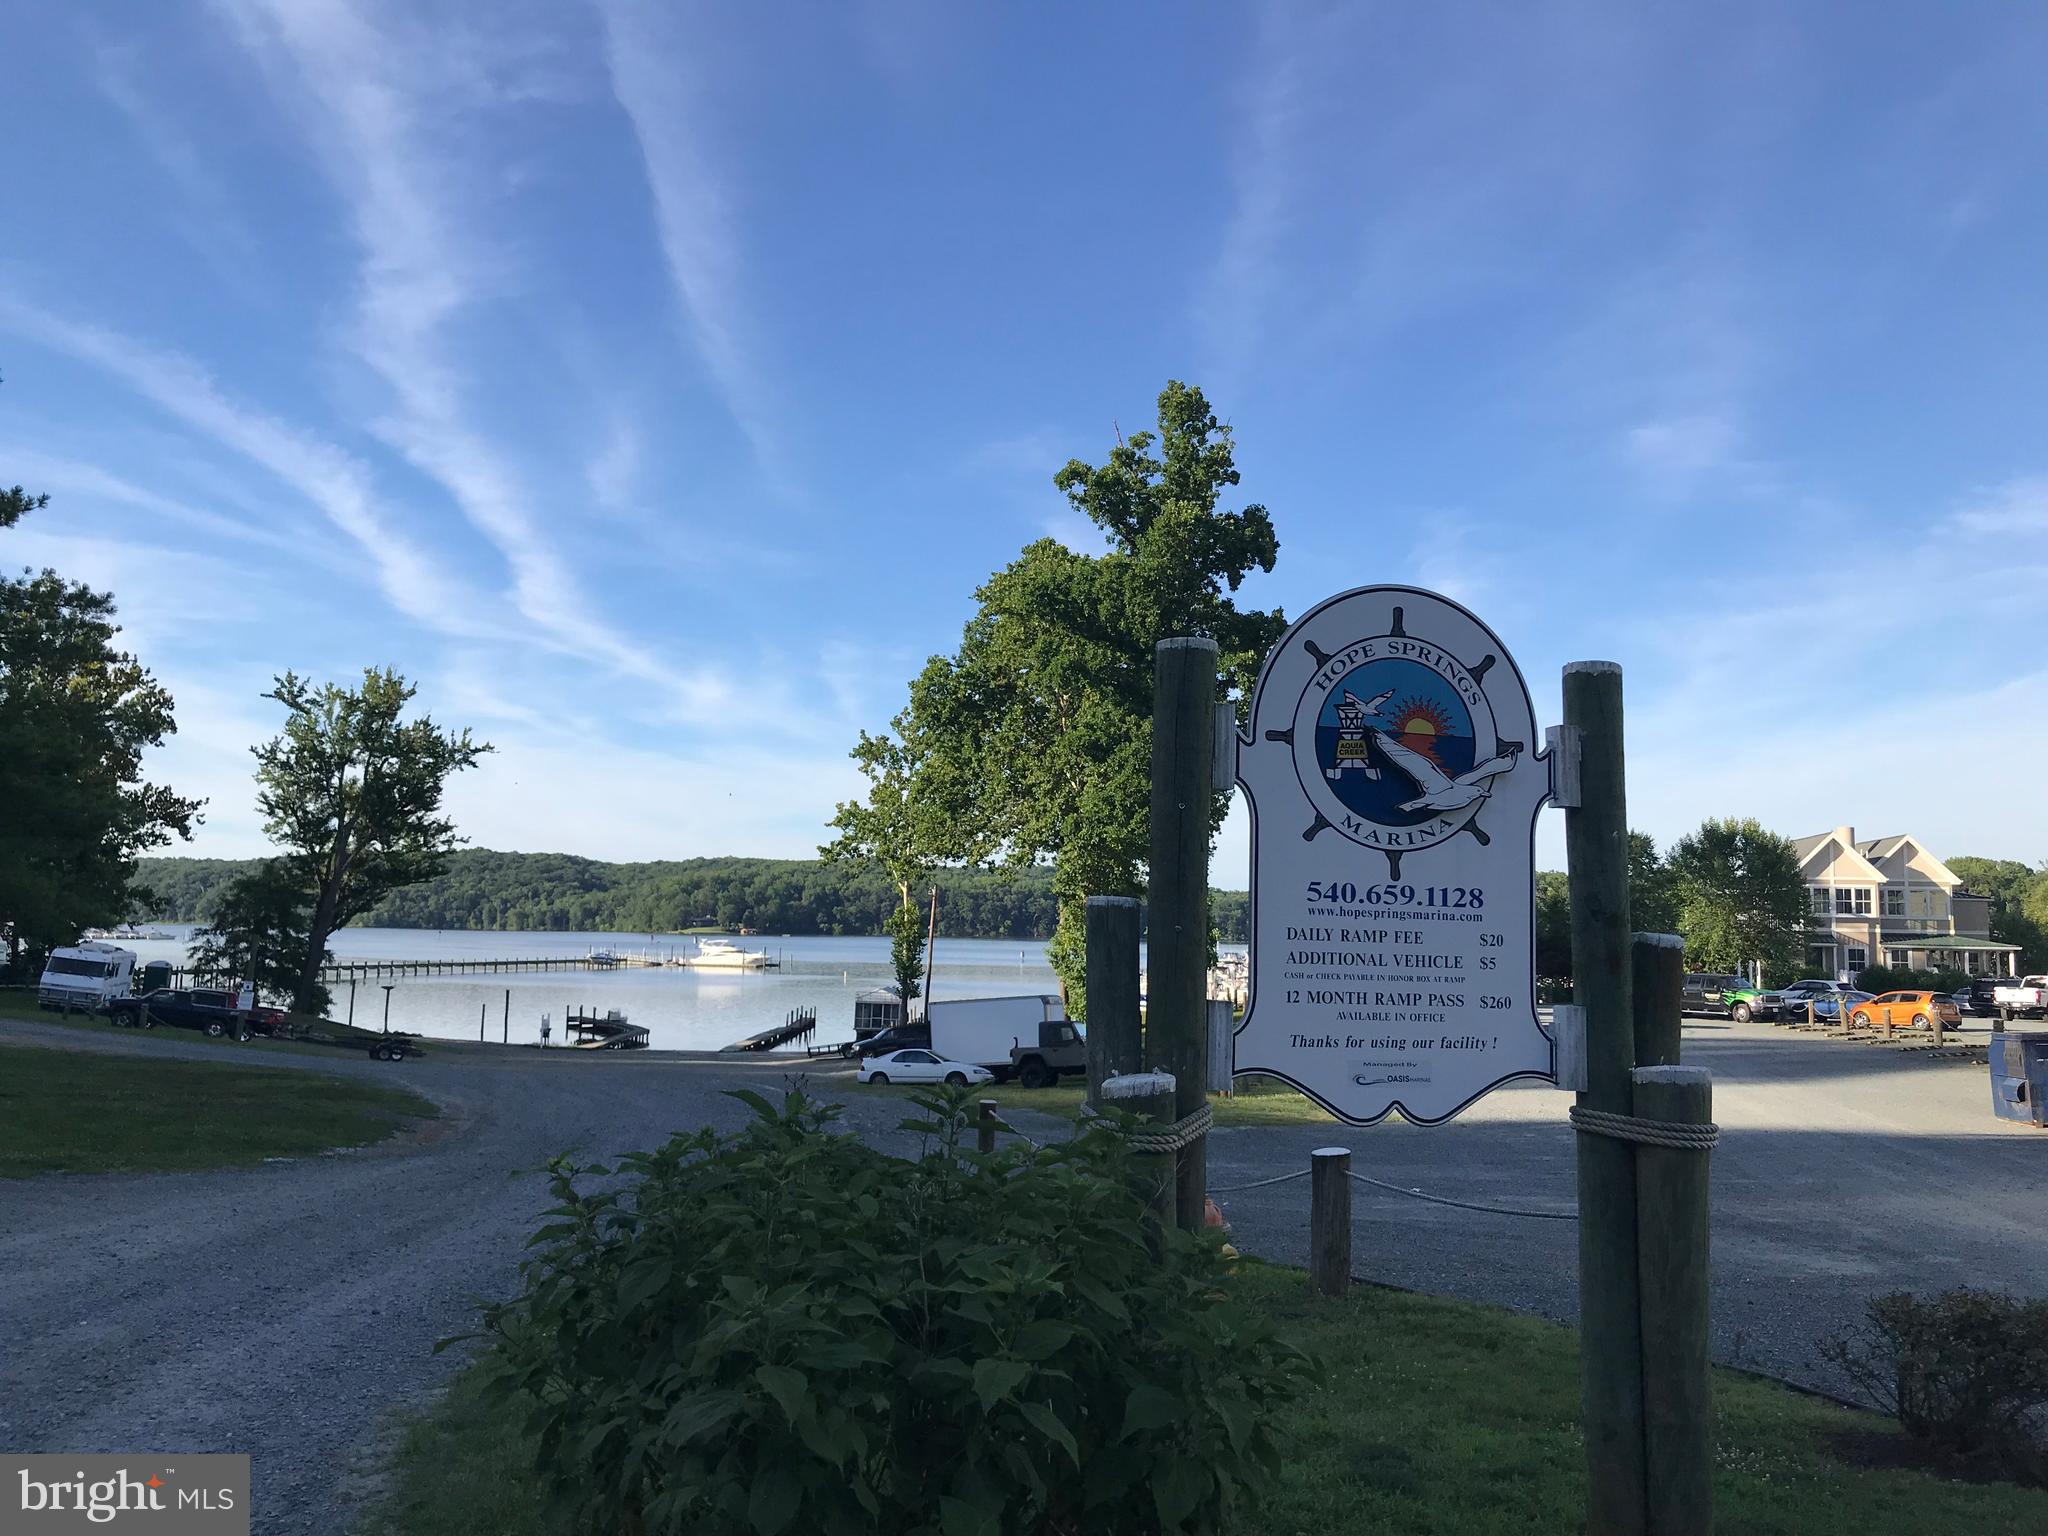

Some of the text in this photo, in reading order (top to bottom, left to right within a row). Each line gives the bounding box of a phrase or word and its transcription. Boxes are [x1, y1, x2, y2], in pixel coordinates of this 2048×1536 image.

[1314, 641, 1481, 707] HOPE SPRINGS
[1340, 814, 1454, 846] MARINA
[1306, 881, 1484, 909] 540.659.1128
[1308, 906, 1483, 922] www.hopespringsmarina.com
[1287, 927, 1503, 947] DAILY RAMP FEE $20
[1286, 951, 1496, 971] ADDITIONAL VEHICLE $5
[1284, 972, 1304, 980] CASH
[1316, 972, 1341, 980] CHECK
[1344, 973, 1374, 981] PAYABLE
[1416, 975, 1431, 983] BOX
[1286, 991, 1511, 1010] 12 MONTH RAMP PASS $260
[1336, 1011, 1446, 1022] AVAILABLE IN OFFICE
[1290, 1034, 1339, 1048] Thanks
[1345, 1035, 1364, 1048] for
[1370, 1036, 1406, 1051] using
[1412, 1038, 1434, 1049] our
[1440, 1035, 1487, 1051] facility
[1387, 1075, 1410, 1083] OASIS
